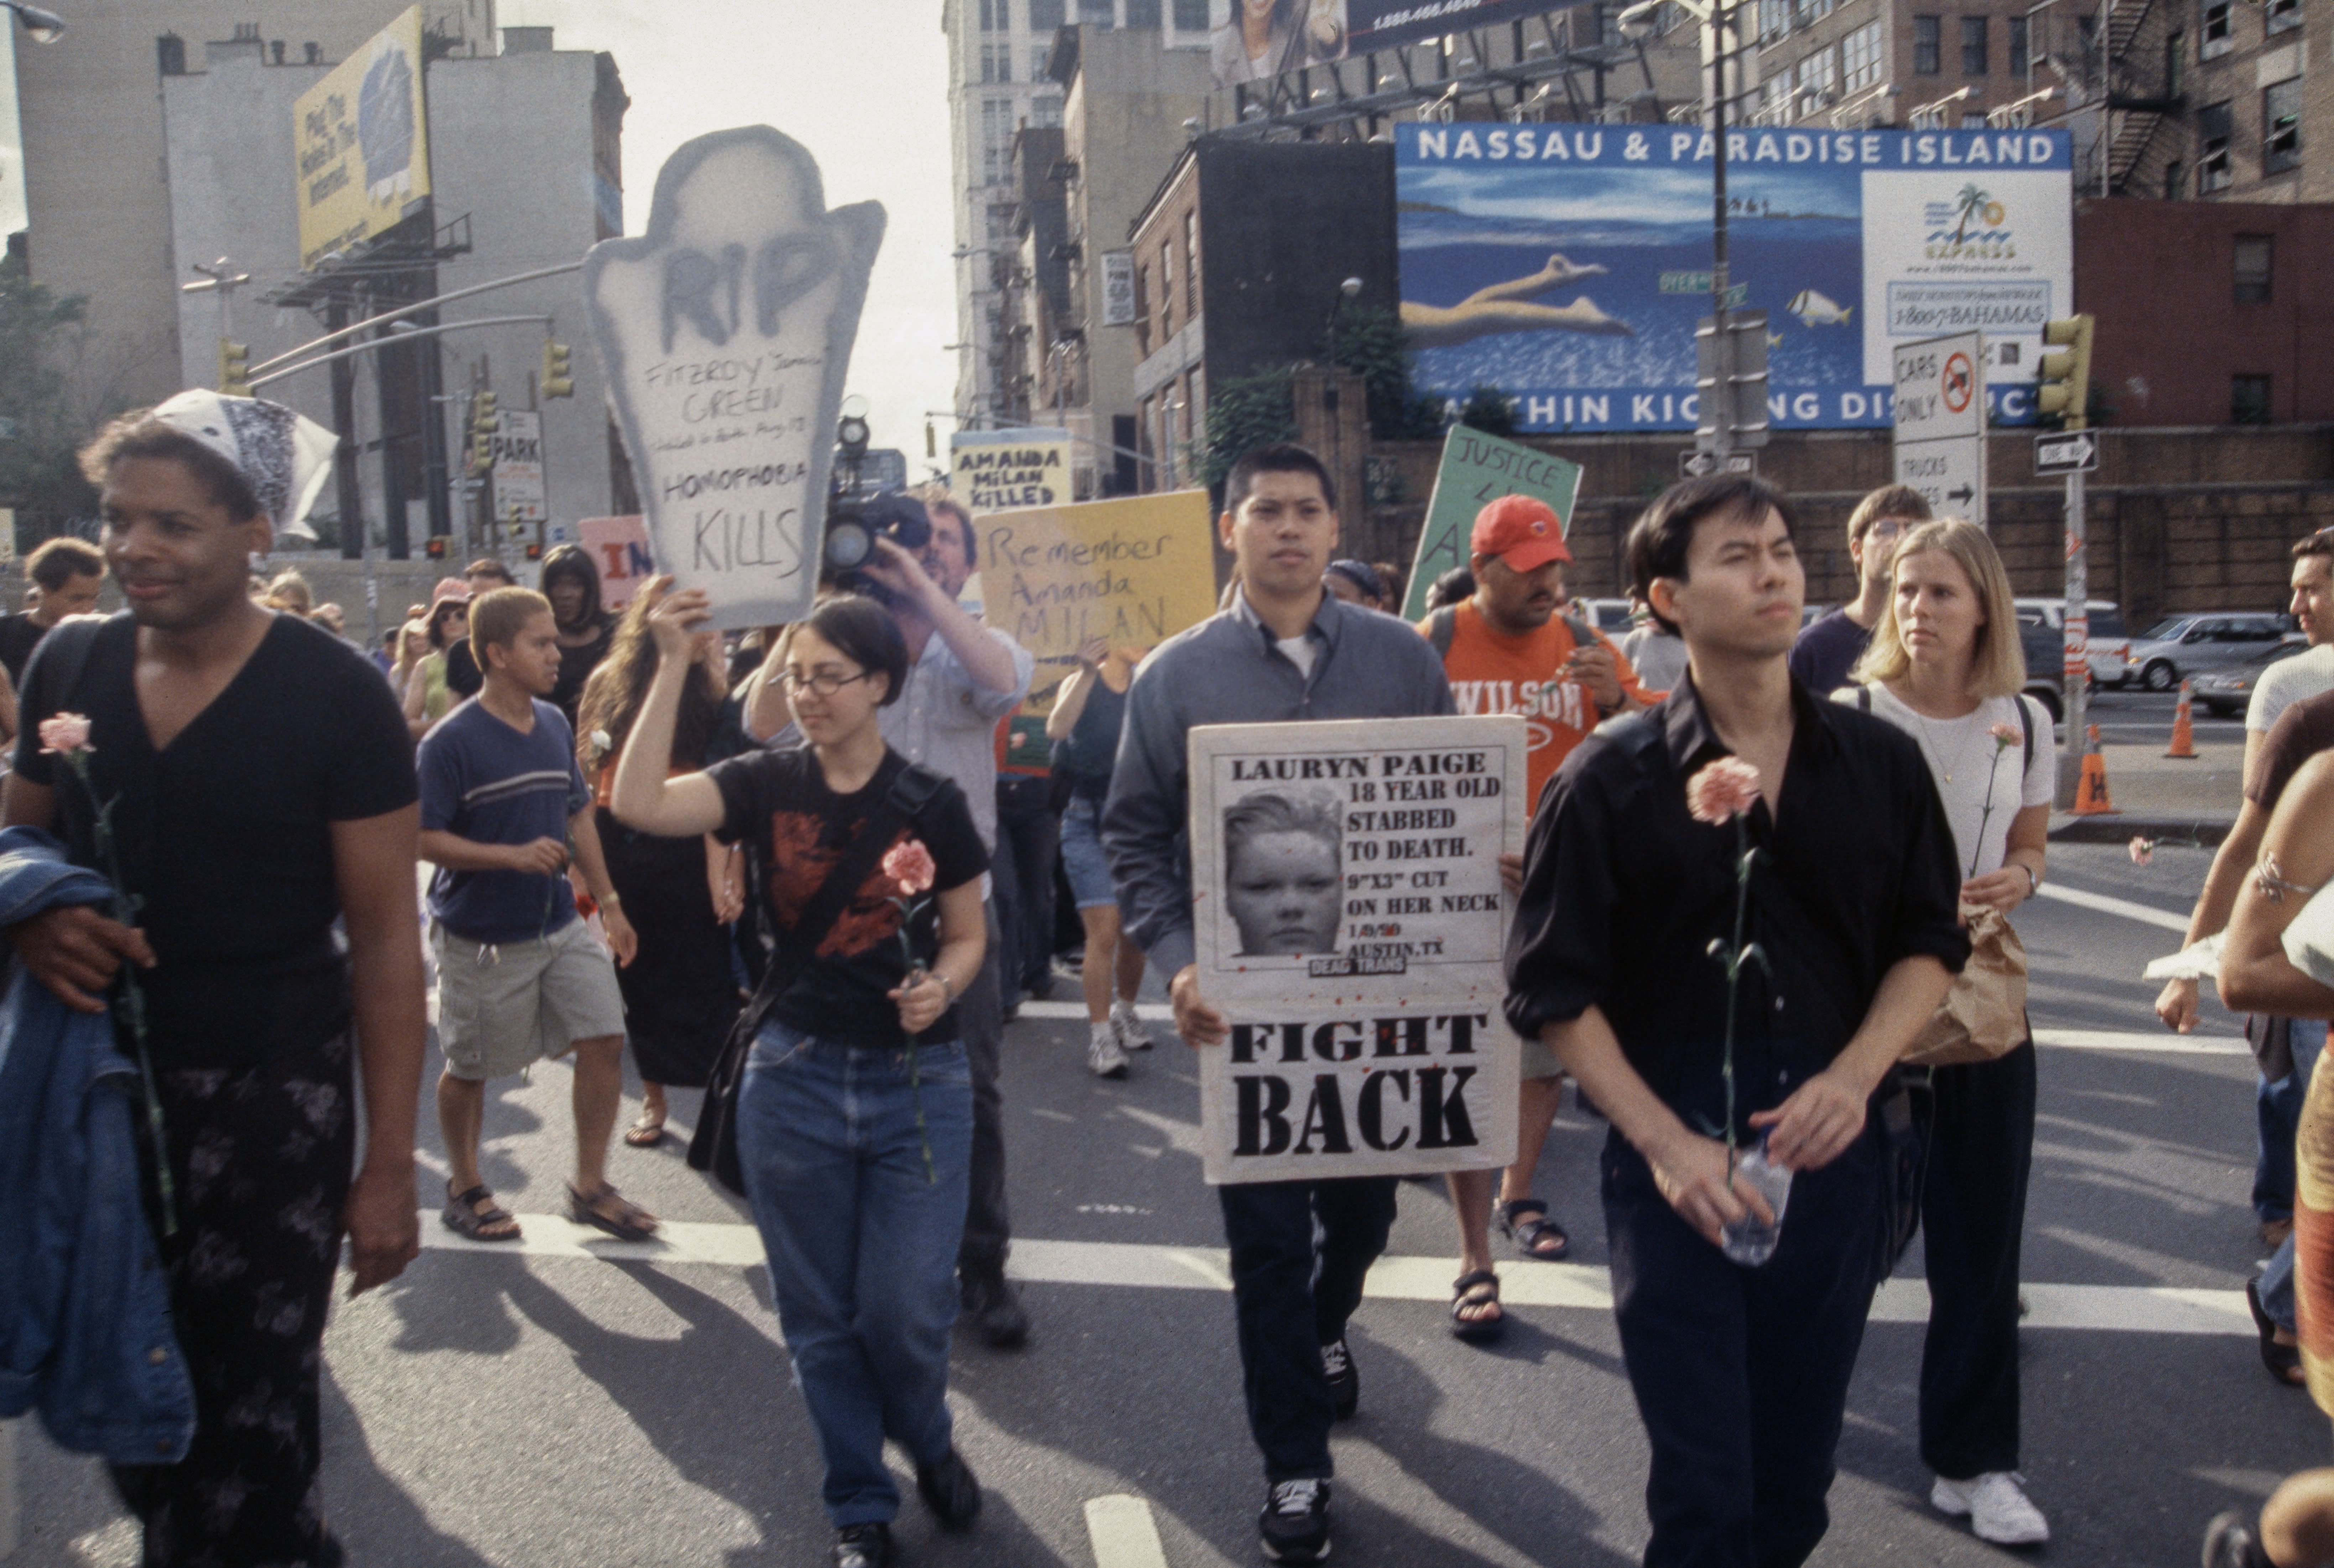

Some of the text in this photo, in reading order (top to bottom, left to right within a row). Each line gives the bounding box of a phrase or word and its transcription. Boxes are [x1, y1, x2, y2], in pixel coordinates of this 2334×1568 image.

[1418, 130, 2055, 164] NASSAU & PARADISE ISLAND
[661, 233, 840, 354] RIP
[644, 356, 763, 387] FITZROY
[1897, 353, 1937, 384] CARS
[682, 384, 784, 423] GREEN
[1632, 393, 1820, 422] KICNG
[958, 448, 1060, 471] AMANDA
[1455, 436, 1559, 489] JUSTICE
[663, 463, 807, 503] HOMOPHOBIA
[693, 507, 803, 579] KILLS
[987, 526, 1172, 569] Remember
[1009, 570, 1136, 608] Amanda
[1016, 596, 1165, 642] MILAN
[1448, 679, 1584, 731] WILSON
[1231, 752, 1486, 781] LAURYN PAIGE
[1350, 777, 1501, 803] 18 YEAR OLD
[1346, 808, 1457, 832] STABBED
[1346, 837, 1474, 861] TO DEATH.
[1411, 870, 1449, 888] CUT
[1347, 894, 1499, 916] ON HER NECK
[1357, 959, 1405, 974] TRANS
[1230, 1014, 1487, 1063] FIGHT
[1233, 1066, 1479, 1156] BACK
